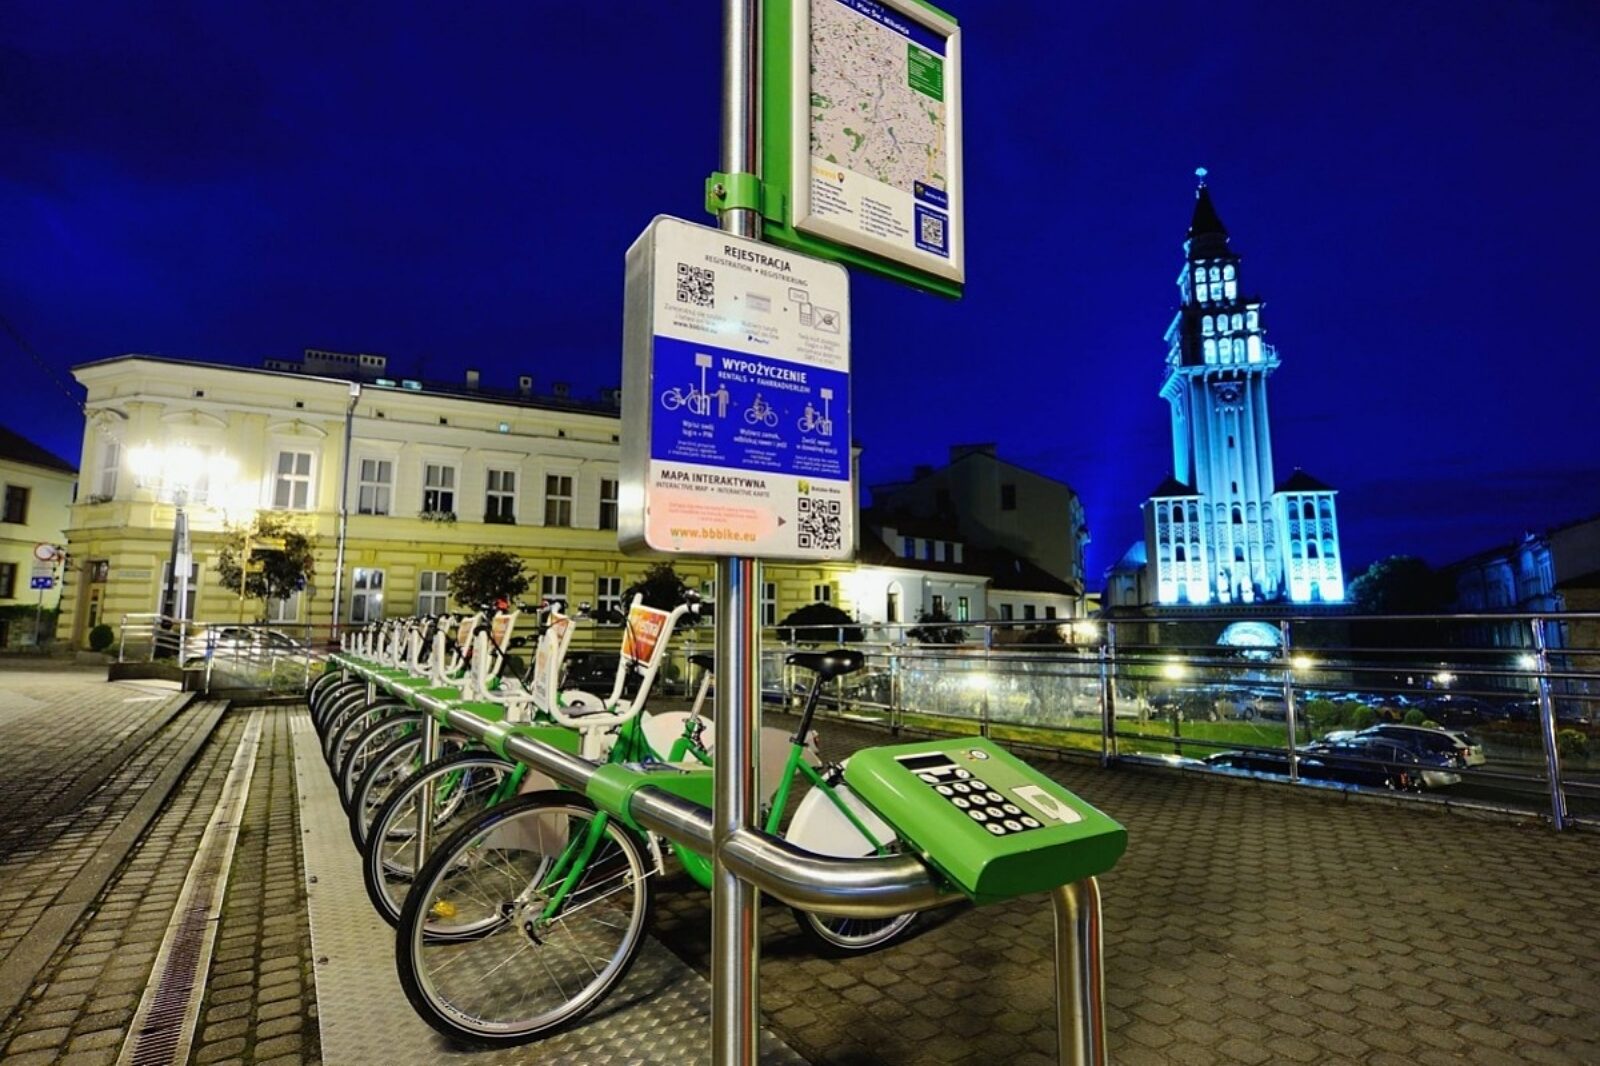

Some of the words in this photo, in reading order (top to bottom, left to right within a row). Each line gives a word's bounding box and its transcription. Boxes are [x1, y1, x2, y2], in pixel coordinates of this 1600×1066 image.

[705, 254, 753, 274] REGISTRATION
[724, 245, 792, 272] REJESTRACJA
[717, 371, 748, 384] RENTALS
[722, 357, 808, 384] WYPOŻYCZENIE
[656, 481, 693, 491] INTERACTIVE
[661, 470, 690, 481] MAPA
[692, 473, 766, 489] INTERAKTYWNA
[670, 527, 756, 542] www.bbbike.eu
